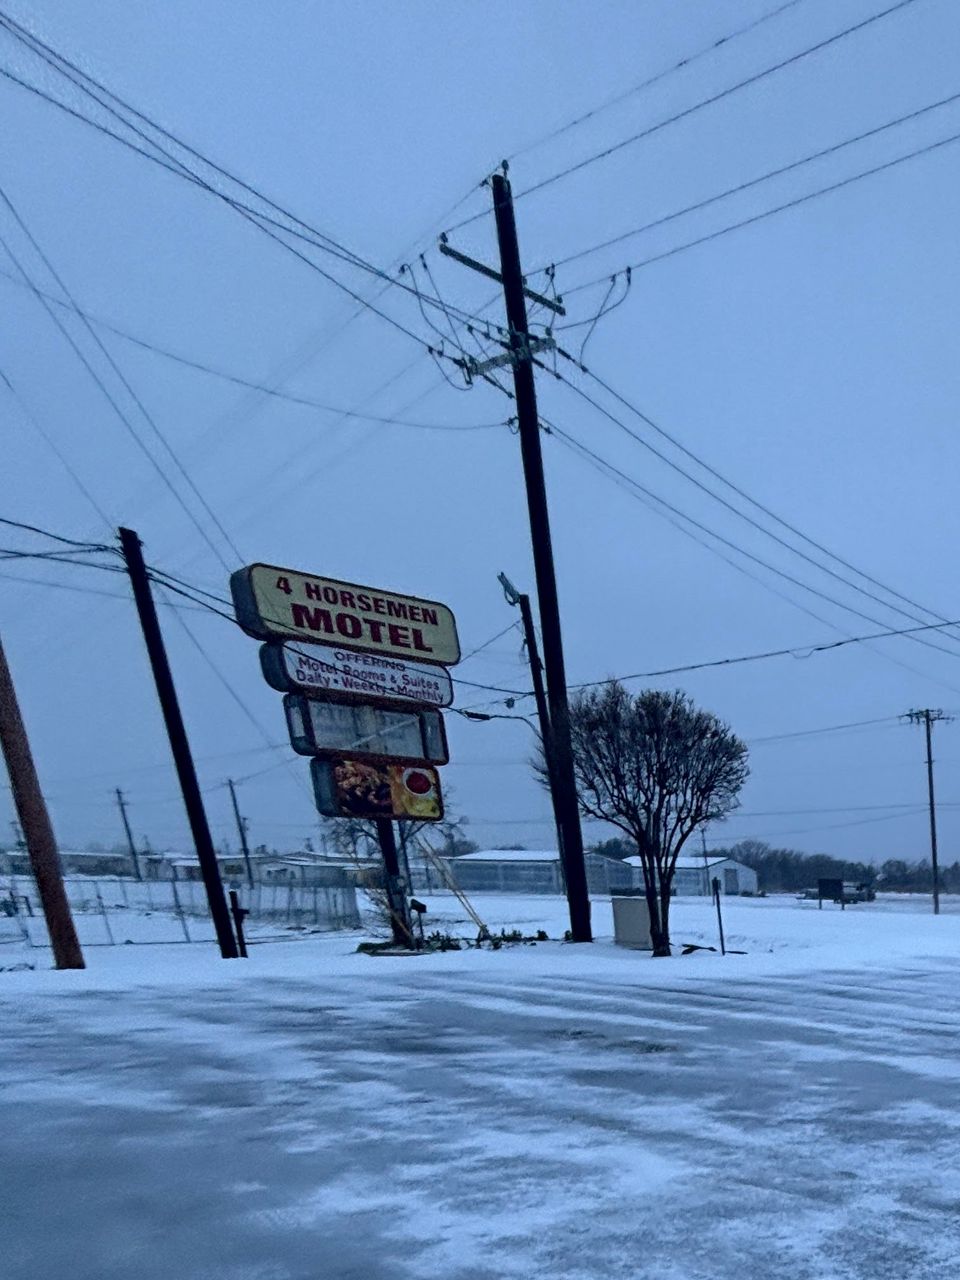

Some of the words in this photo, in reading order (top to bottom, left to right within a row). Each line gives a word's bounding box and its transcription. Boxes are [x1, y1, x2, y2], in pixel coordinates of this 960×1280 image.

[276, 577, 292, 595] 4
[305, 582, 439, 626] HORSEMEN
[291, 603, 433, 652] MOTEL
[298, 657, 338, 676] Motel
[342, 665, 386, 683] Rooms
[402, 674, 440, 691] Suites
[334, 651, 406, 672] OFFERING
[296, 669, 331, 686] Daily
[342, 676, 387, 696] Weekly
[395, 686, 444, 703] Monthly
